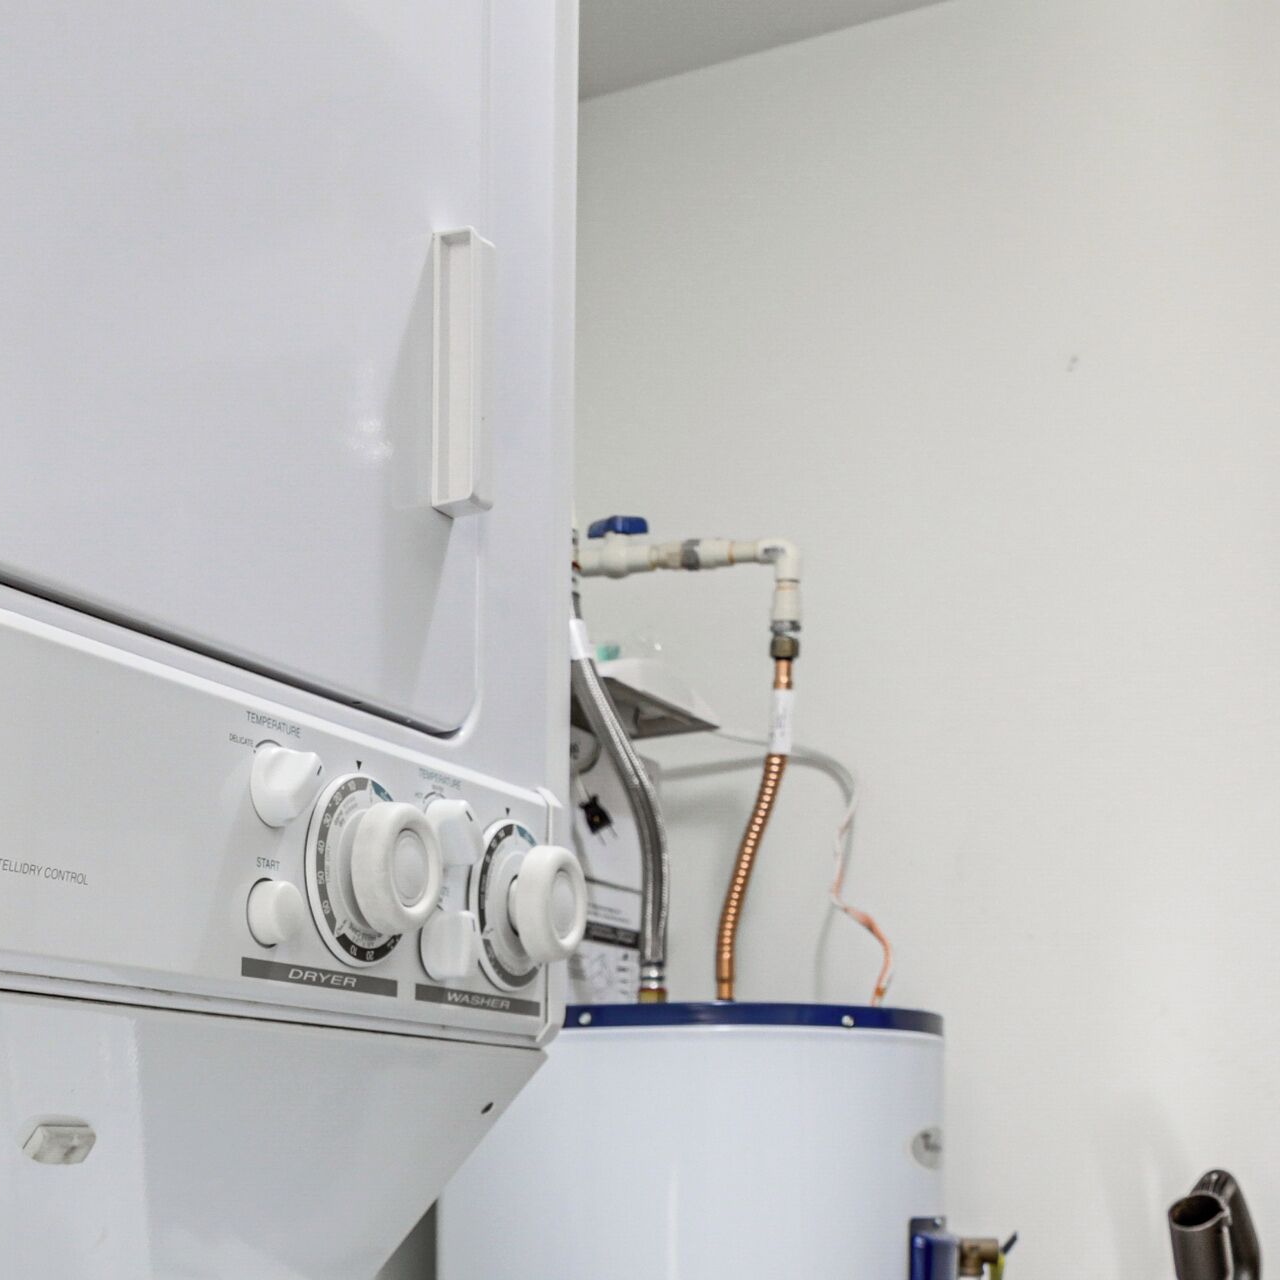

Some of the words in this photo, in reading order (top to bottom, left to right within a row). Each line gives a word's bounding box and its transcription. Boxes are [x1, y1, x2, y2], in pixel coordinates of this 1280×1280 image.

[246, 711, 301, 738] TEMPERATURE
[229, 733, 254, 748] DELICATE
[256, 857, 280, 871] START
[43, 867, 89, 886] CONTROL
[288, 968, 357, 988] DRYER
[447, 991, 511, 1010] WASHER
